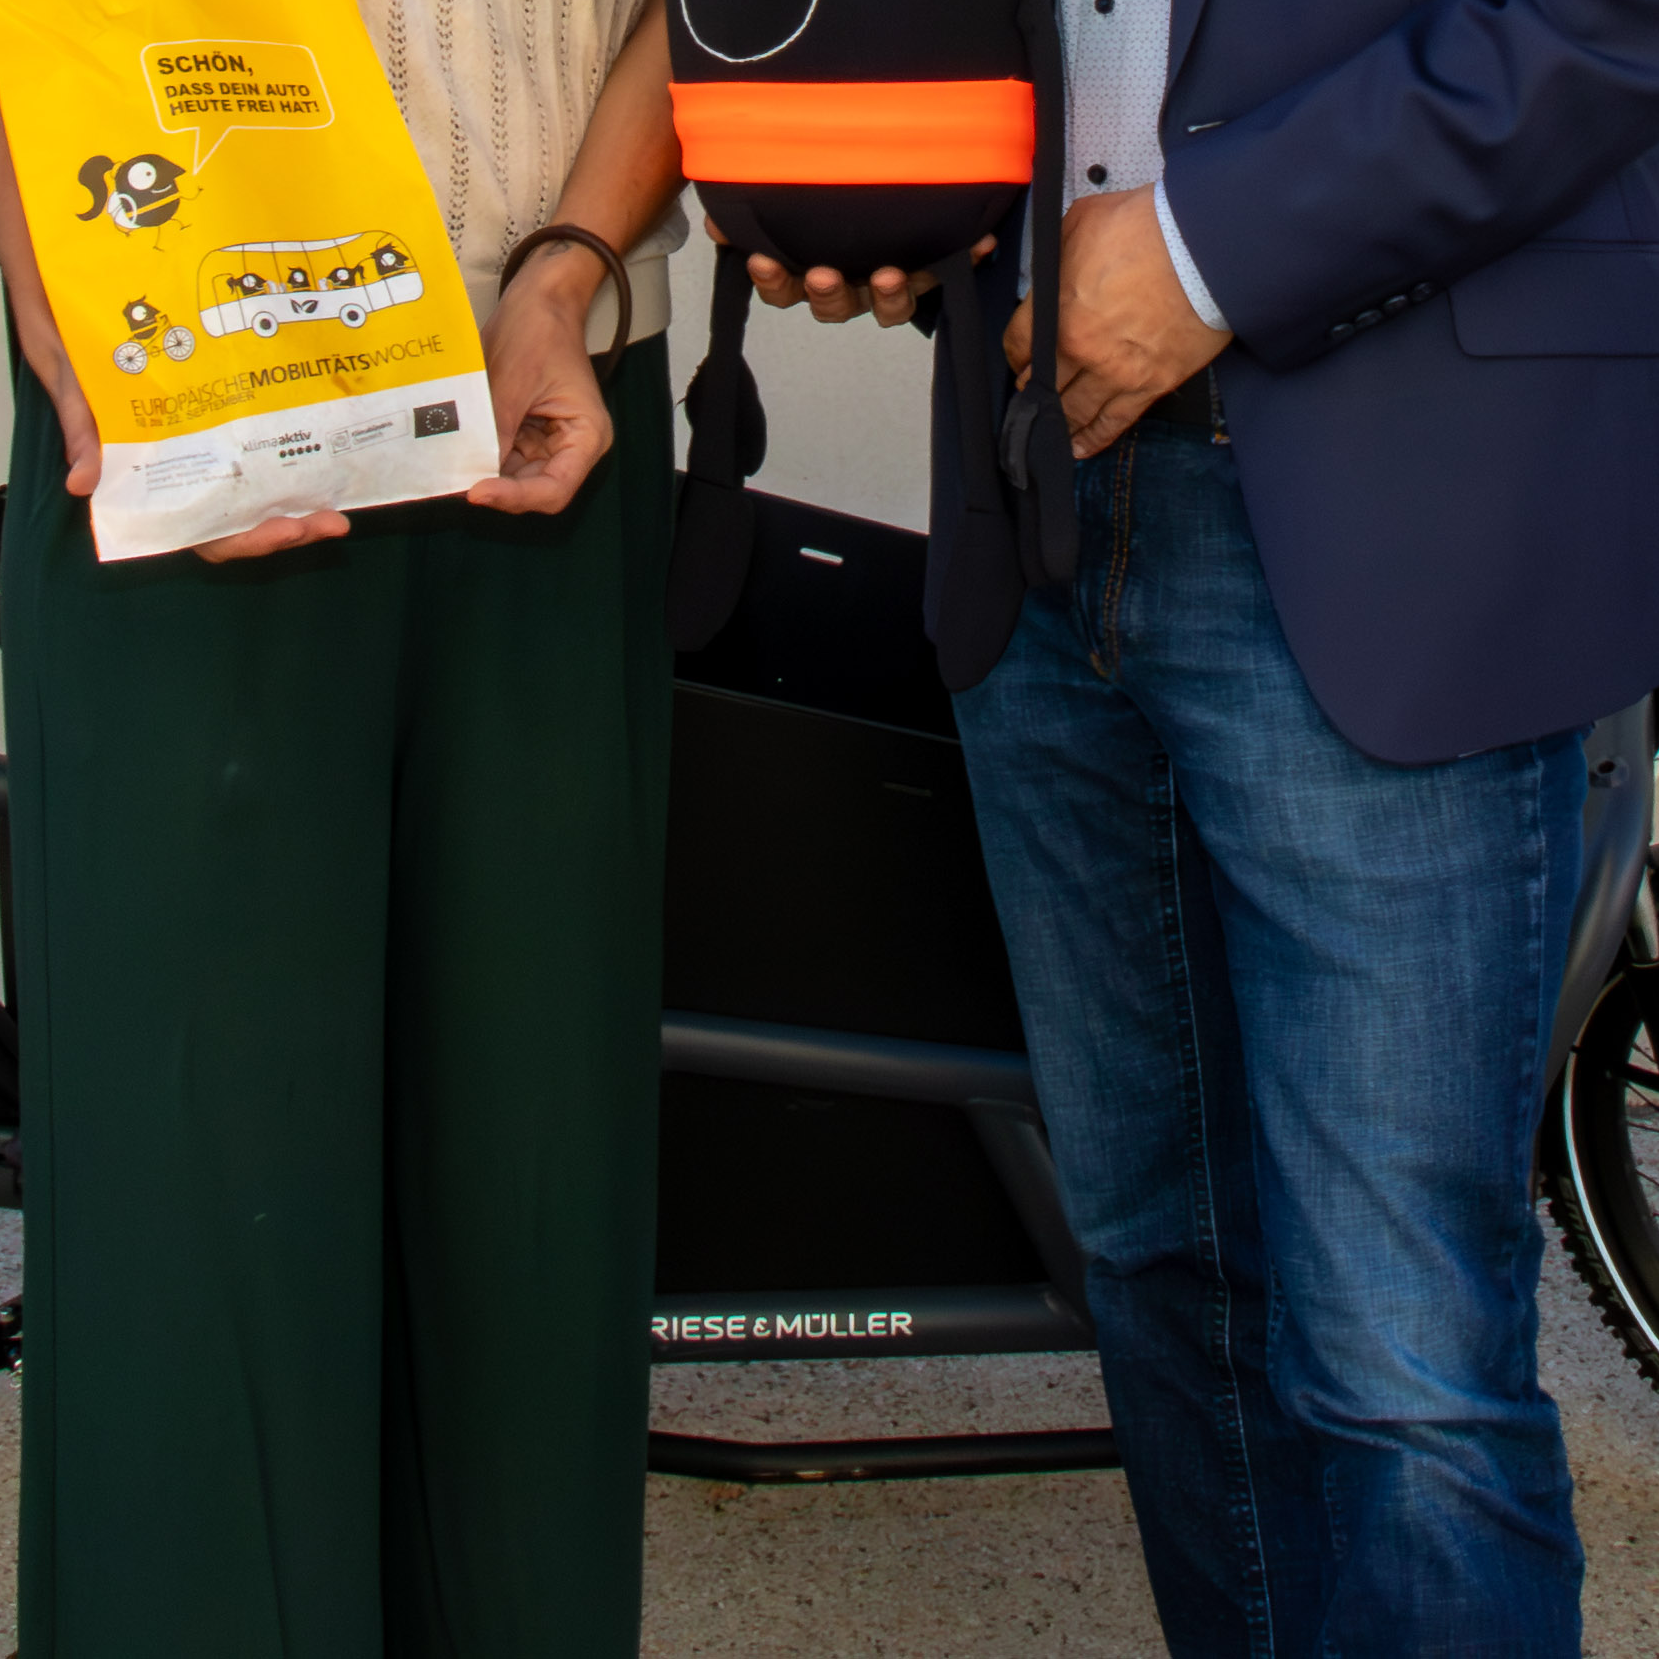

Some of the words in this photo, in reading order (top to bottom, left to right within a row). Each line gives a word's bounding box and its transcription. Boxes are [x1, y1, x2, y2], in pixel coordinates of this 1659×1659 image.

[157, 51, 255, 77] SCHÖN,
[165, 82, 215, 98] DASS
[219, 82, 260, 96] DEIN
[266, 84, 311, 97] AUTO
[170, 99, 233, 116] HEUTE
[236, 99, 275, 113] FREI
[279, 100, 320, 114] HAT!
[186, 391, 256, 420] SEPTEMBER
[242, 429, 313, 454] klimaaktiv
[651, 1314, 747, 1342] RIESE
[775, 1311, 914, 1341] MÜLLER
